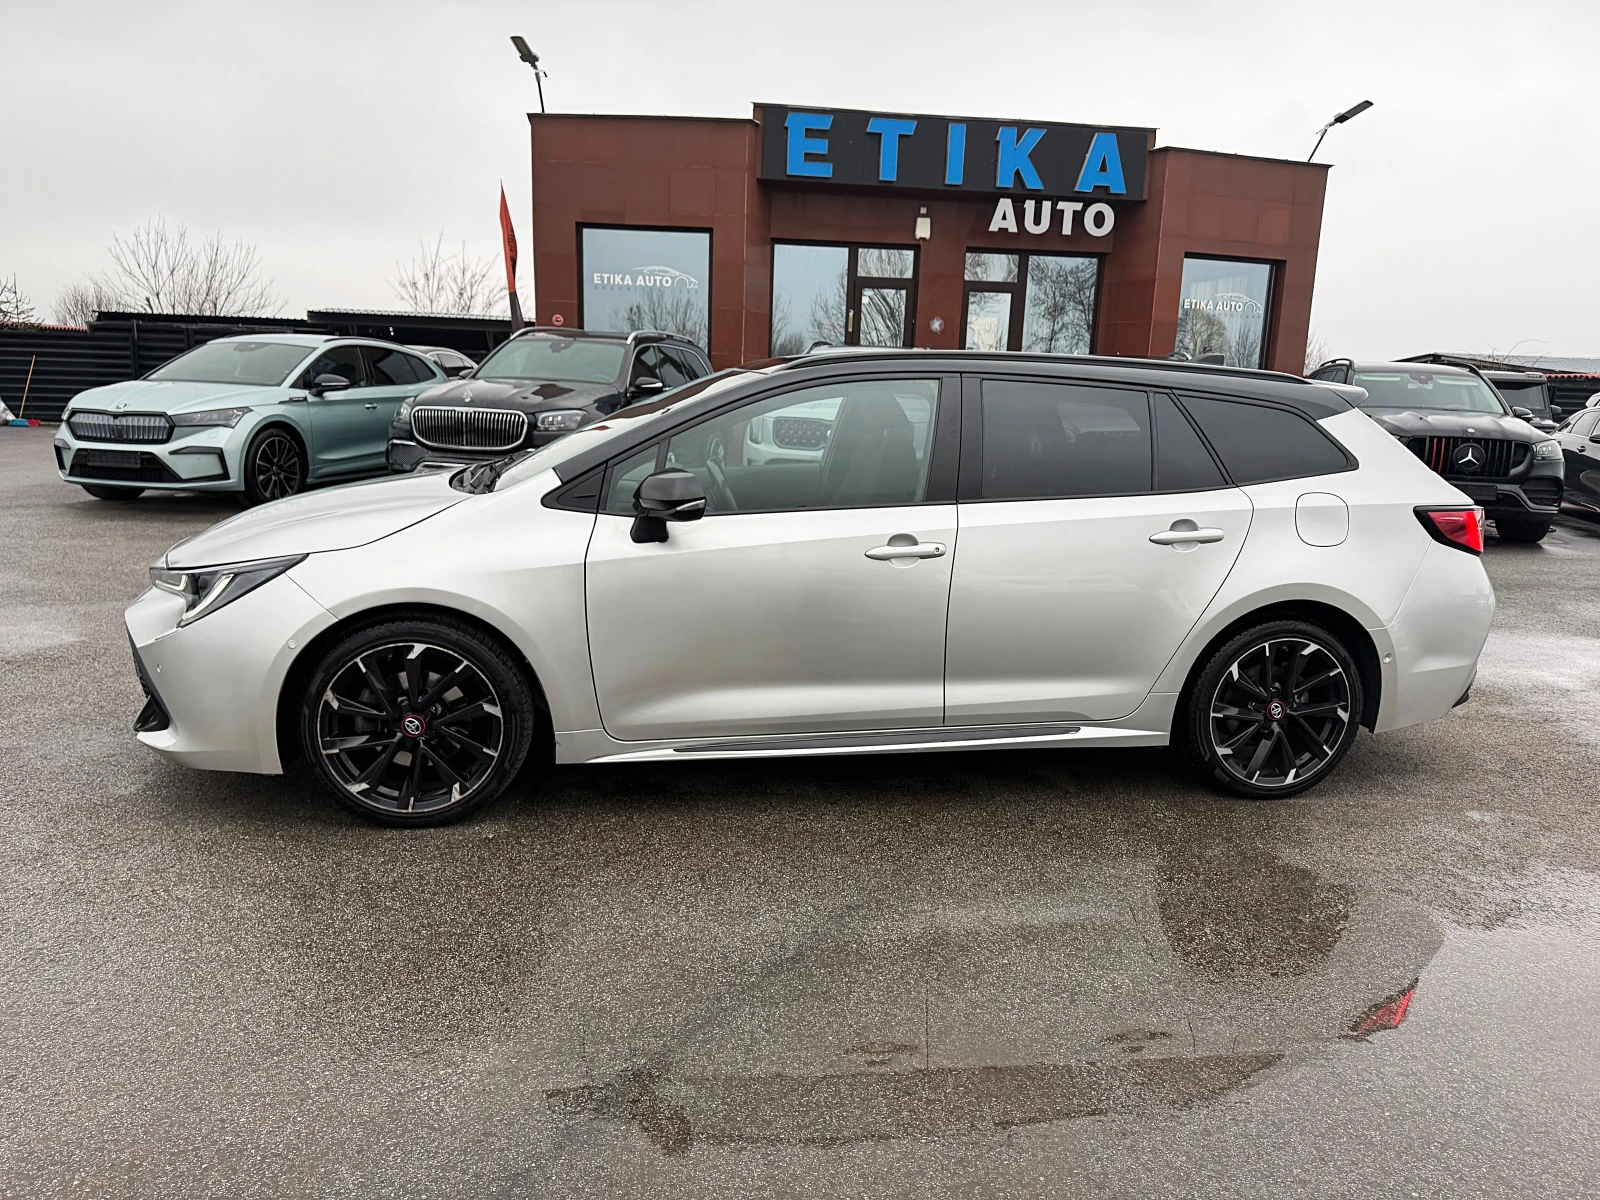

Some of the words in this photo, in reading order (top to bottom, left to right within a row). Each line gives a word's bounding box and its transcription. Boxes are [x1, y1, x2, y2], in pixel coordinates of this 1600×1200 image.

[785, 112, 1127, 194] ETIKA
[988, 198, 1115, 237] AUTO
[593, 273, 633, 286] ETIKA
[636, 275, 672, 287] AUTO
[1183, 298, 1213, 311] ETIKA
[1215, 301, 1243, 312] AUTO
